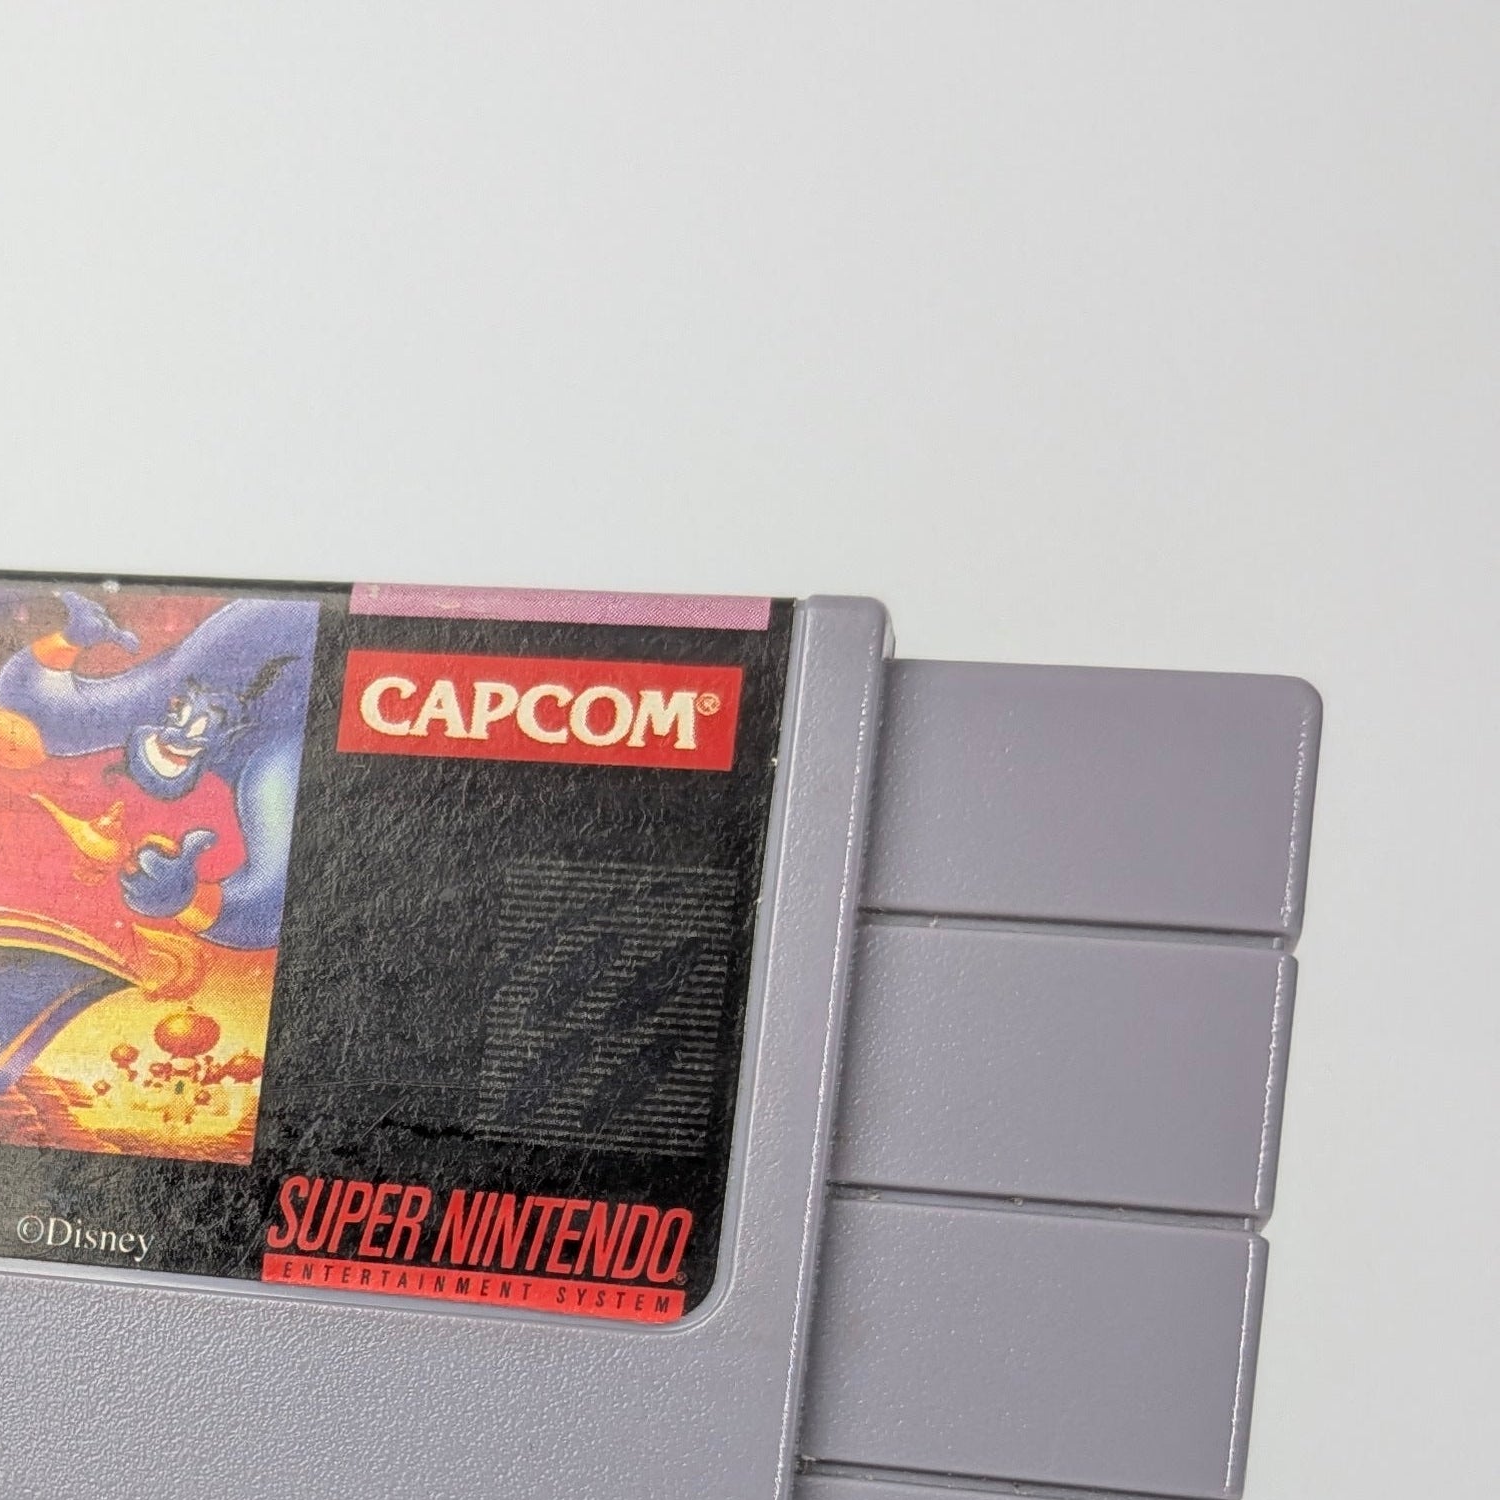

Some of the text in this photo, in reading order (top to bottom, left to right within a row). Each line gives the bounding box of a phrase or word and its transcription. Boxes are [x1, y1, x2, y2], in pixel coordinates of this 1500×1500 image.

[266, 1175, 433, 1261] SUPER
[282, 1261, 670, 1313] ENTERTAINMENT SYSTEM
